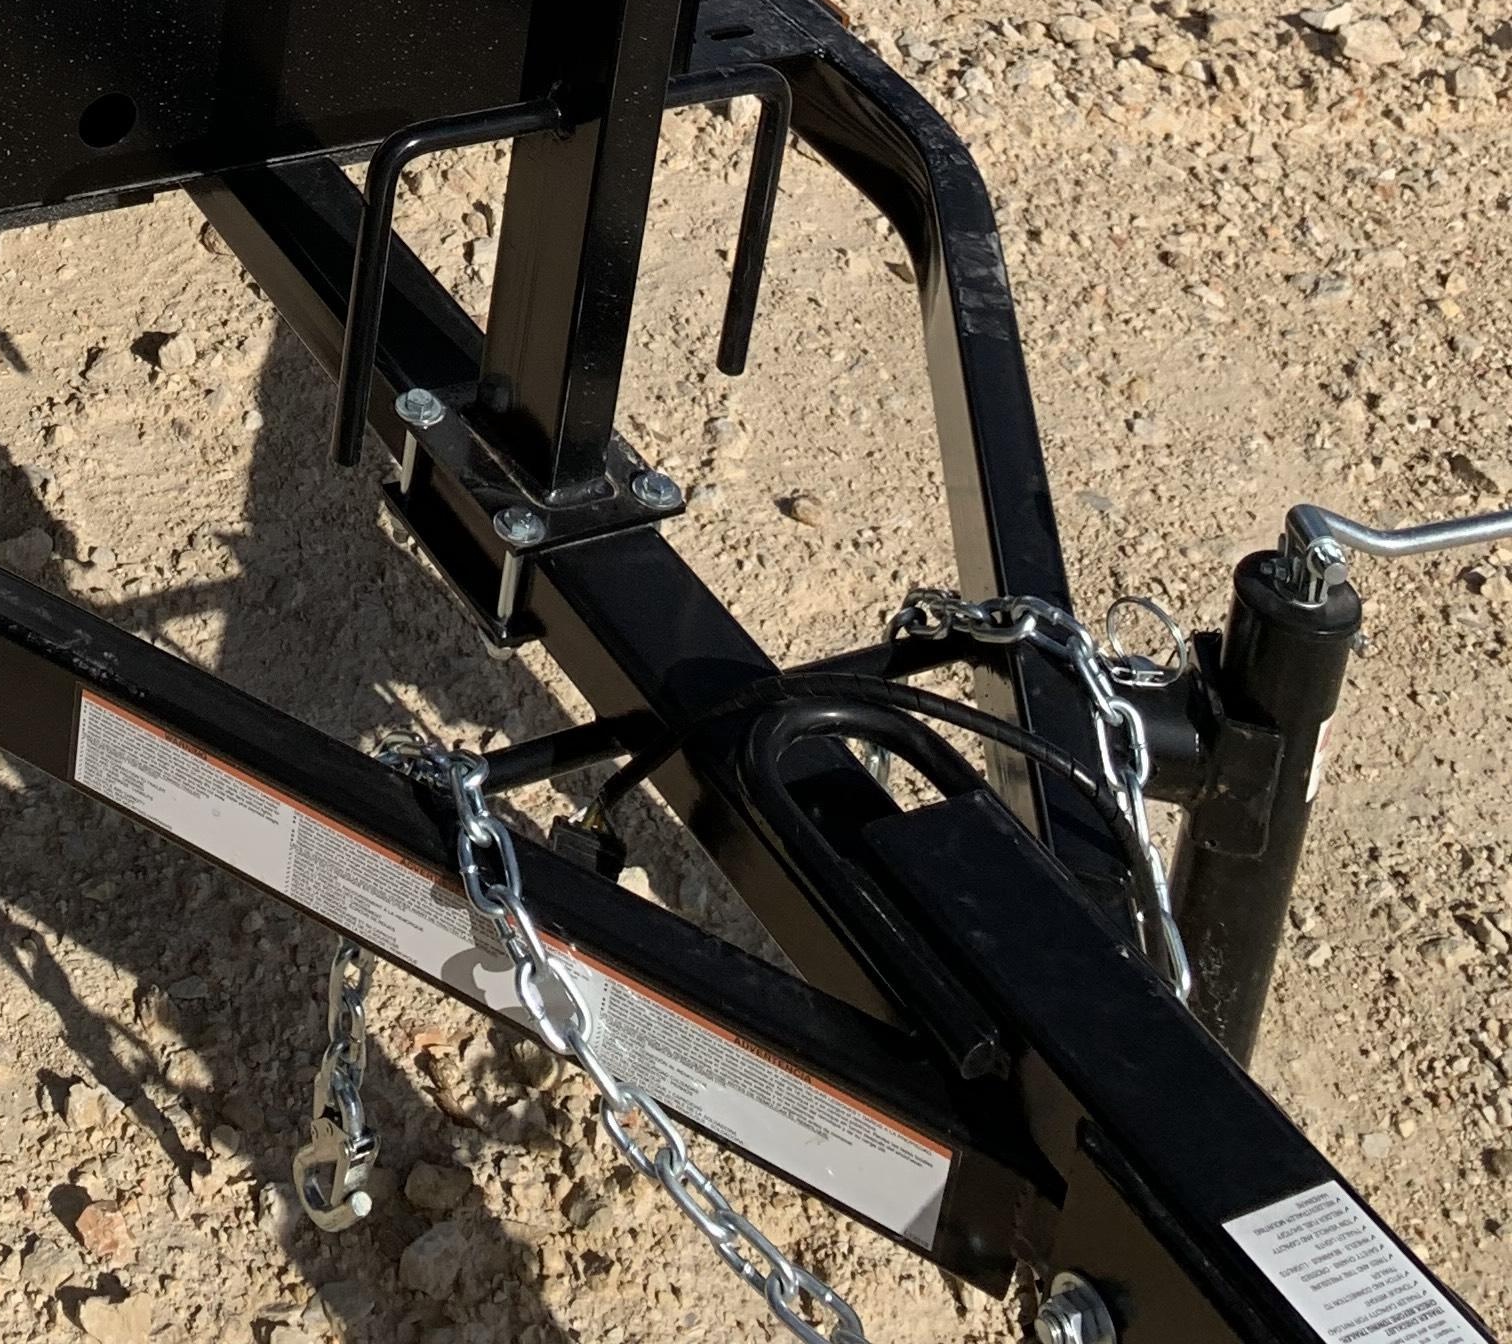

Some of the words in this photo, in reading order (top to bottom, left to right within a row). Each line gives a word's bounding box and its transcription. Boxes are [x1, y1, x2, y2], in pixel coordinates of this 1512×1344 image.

[1414, 1299, 1437, 1311] CHECK
[1354, 1315, 1369, 1323] FOR
[1389, 1308, 1416, 1321] BEFORE
[1416, 1307, 1444, 1321] TRAILER
[1366, 1318, 1391, 1331] TOWING
[1384, 1318, 1419, 1335] CHECKLIST
